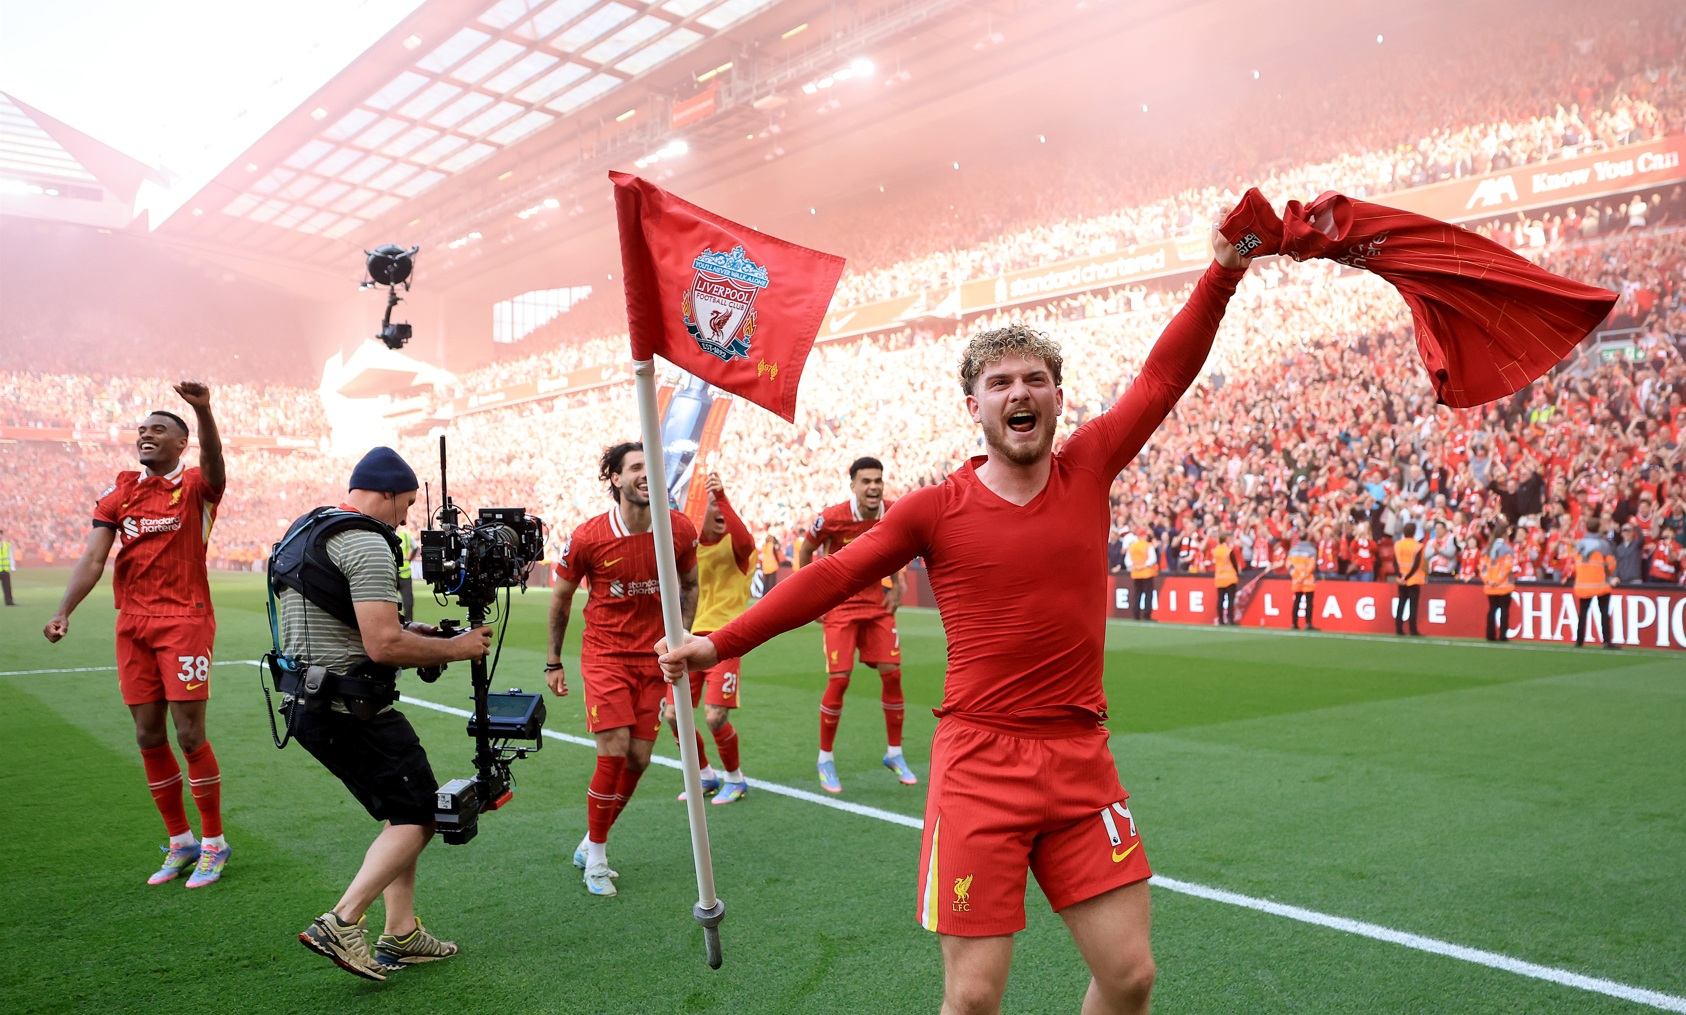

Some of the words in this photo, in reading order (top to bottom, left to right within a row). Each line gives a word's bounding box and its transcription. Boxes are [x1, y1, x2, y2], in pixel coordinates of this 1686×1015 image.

[1532, 168, 1591, 193] Know
[1594, 159, 1634, 181] You
[1637, 151, 1679, 172] Can
[695, 261, 713, 271] YOU'LL
[713, 265, 731, 276] NEVER
[731, 270, 747, 280] WALK
[747, 275, 767, 286] ALONE
[1010, 265, 1080, 297] standard
[1082, 248, 1165, 283] chartered
[696, 280, 750, 303] LIVERPOOL
[696, 292, 727, 306] FOOTBALL
[728, 301, 745, 311] CLUB
[892, 627, 900, 648] 7
[177, 655, 210, 682] 38
